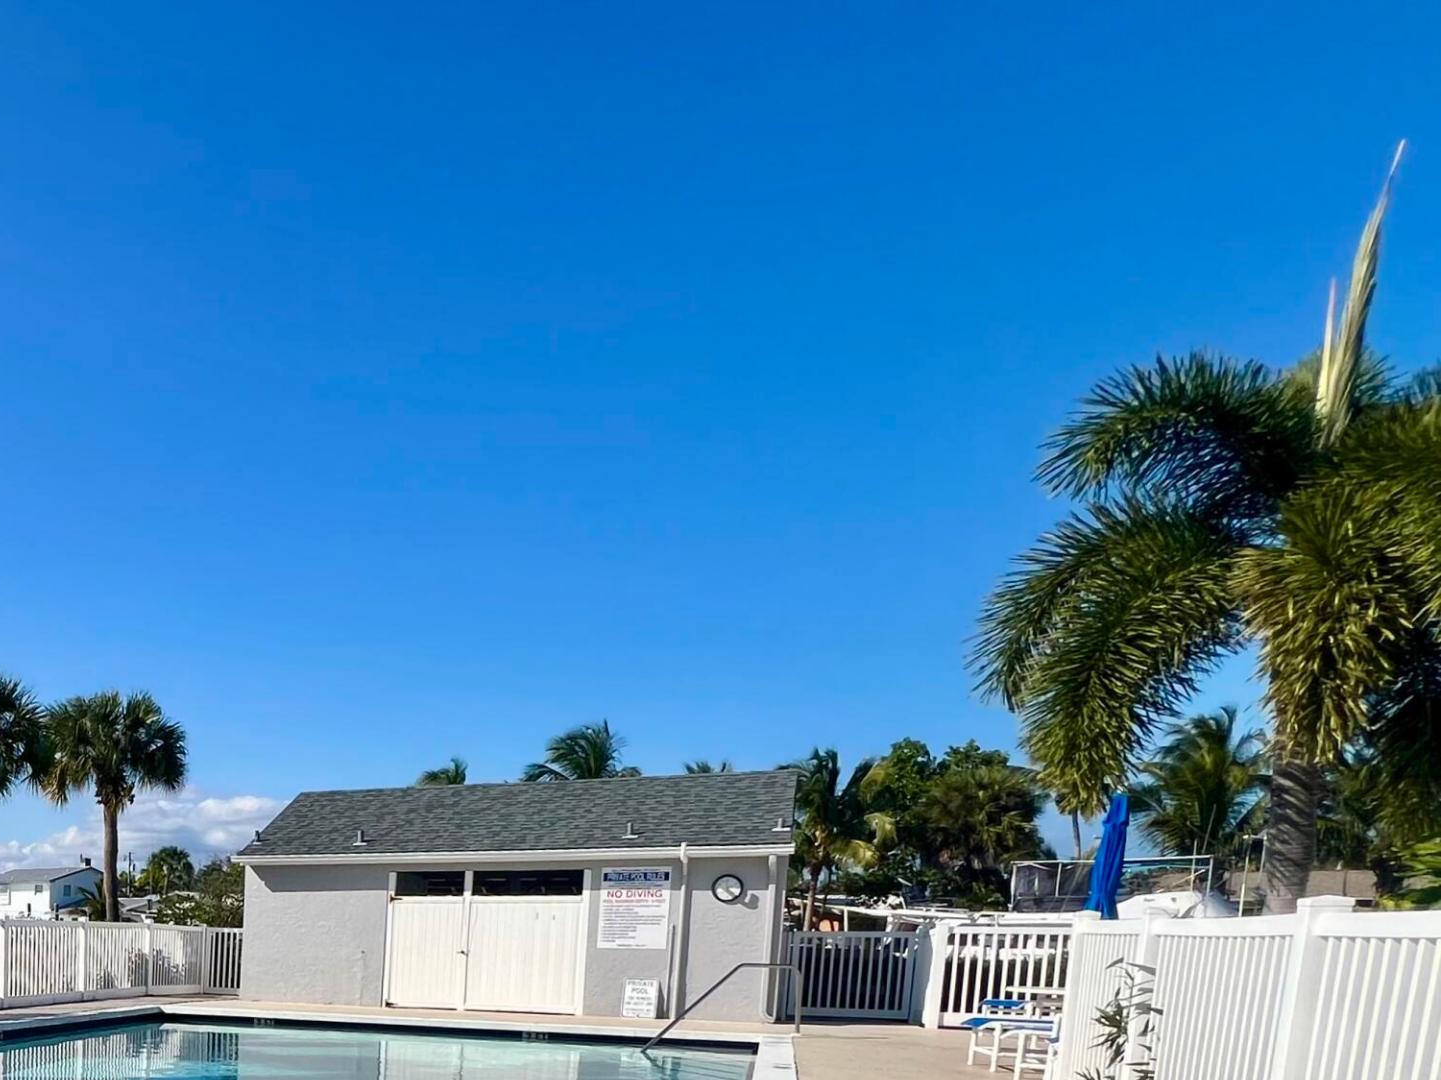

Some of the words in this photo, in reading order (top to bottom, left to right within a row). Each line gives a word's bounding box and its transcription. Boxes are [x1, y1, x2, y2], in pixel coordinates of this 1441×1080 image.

[630, 872, 646, 880] POOL
[607, 889, 623, 898] NO
[626, 889, 663, 898] DIVING
